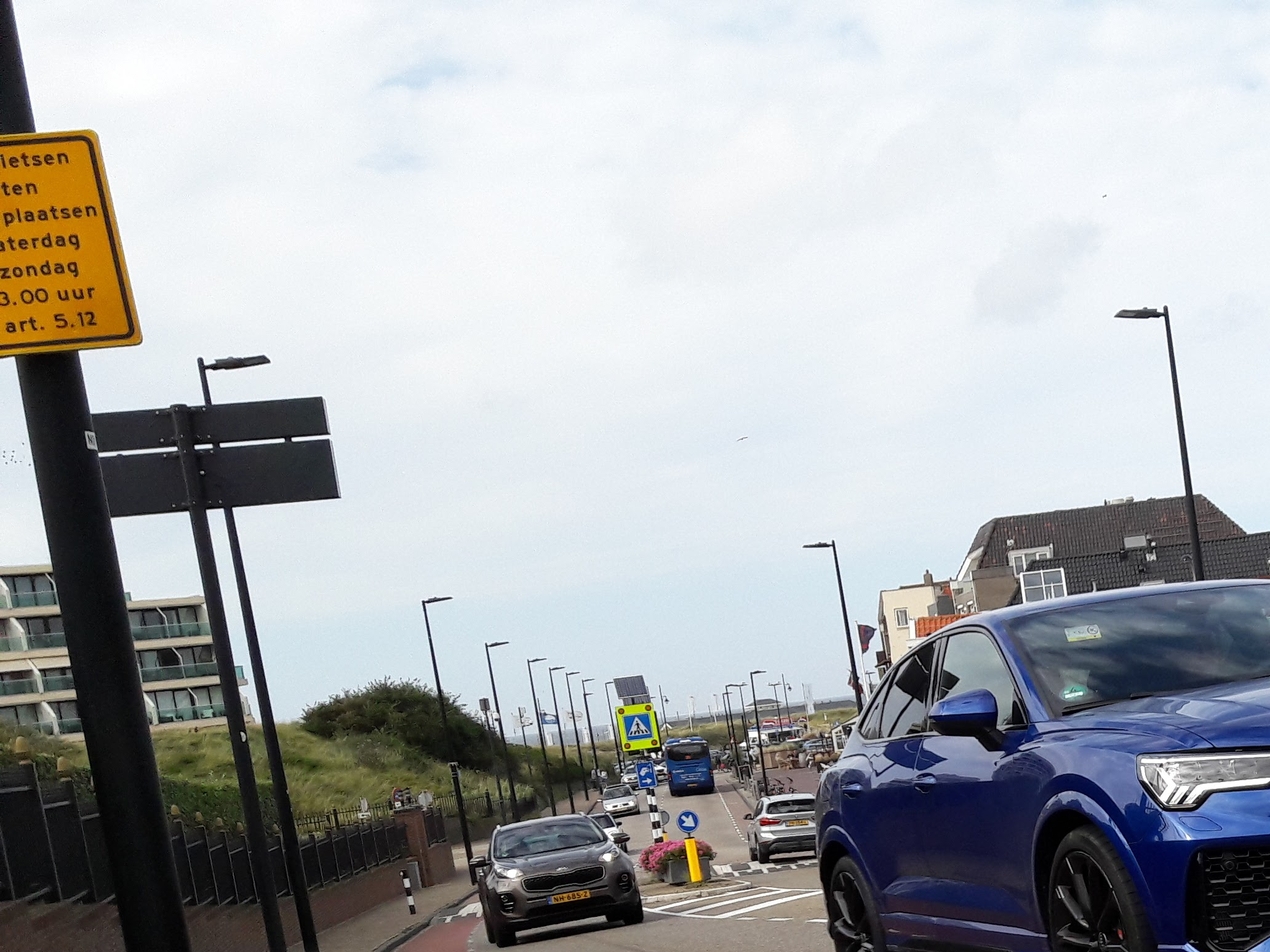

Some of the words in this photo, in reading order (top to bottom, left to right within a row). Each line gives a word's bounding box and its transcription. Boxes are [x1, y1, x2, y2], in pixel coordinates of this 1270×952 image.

[1, 181, 38, 196] ten
[3, 205, 98, 227] plaatsen
[0, 260, 79, 279] zondag
[57, 287, 95, 301] uur
[5, 316, 45, 333] art.
[53, 311, 97, 329] 5.12
